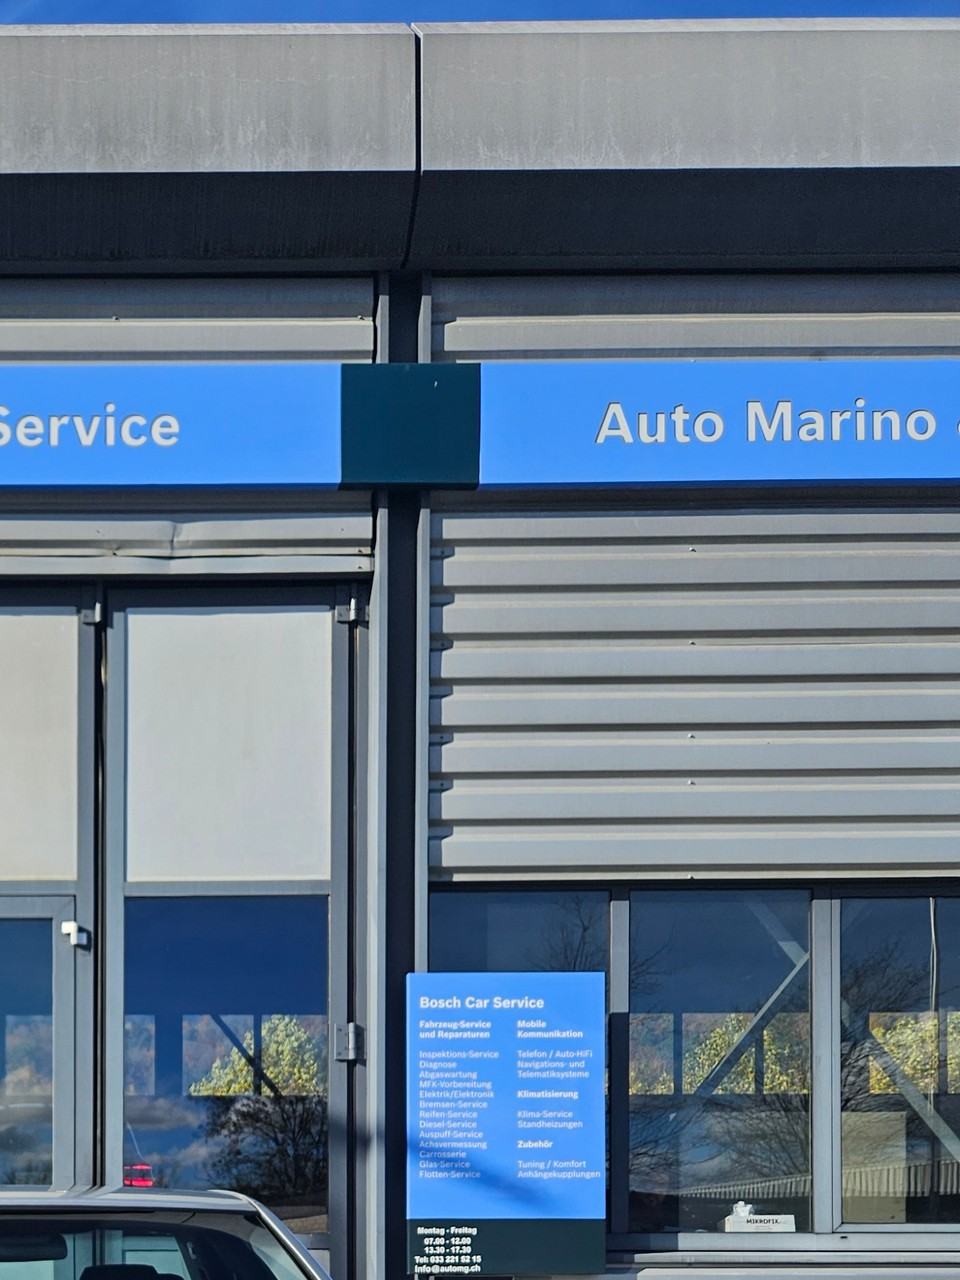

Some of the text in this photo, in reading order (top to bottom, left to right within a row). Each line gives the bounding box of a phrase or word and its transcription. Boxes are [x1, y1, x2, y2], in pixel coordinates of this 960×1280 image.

[594, 401, 723, 443] Auto
[746, 398, 936, 441] Marino
[419, 996, 544, 1009] Bosch Car Service
[419, 1020, 492, 1030] Fahrzeug-Service
[517, 1020, 546, 1028] Mobile
[419, 1030, 490, 1040] und Reparaturen
[517, 1030, 583, 1038] Kommunikation
[419, 1050, 499, 1060] Inspektions-Service
[517, 1050, 547, 1058] Telefon
[555, 1050, 593, 1058] Auto-HiFi
[419, 1060, 457, 1070] Diagnose
[517, 1060, 585, 1070] Navigations- und
[419, 1070, 478, 1080] Abgaswartung
[517, 1070, 590, 1080] Telematiksysteme
[419, 1080, 492, 1090] MFK-Vorbereitung
[419, 1090, 495, 1099] Elektrik/Elektronik
[517, 1090, 579, 1100] Klimatisierung
[419, 1100, 488, 1109] Bremsen-Service
[419, 1110, 478, 1118] Reifen-Service
[517, 1110, 573, 1118] Klima-Service
[419, 1120, 477, 1128] Diesel-Service
[517, 1120, 583, 1130] Standheizungen
[419, 1130, 484, 1139] Auspuff-Service
[419, 1140, 488, 1150] Achsvermessung
[517, 1140, 553, 1148] Zubehör
[419, 1150, 467, 1158] Carrosserie
[419, 1160, 471, 1168] Glas-Service
[517, 1160, 545, 1170] Tuning
[553, 1160, 586, 1168] Komfort
[419, 1170, 481, 1178] Flotten-Service
[517, 1170, 601, 1180] Anhängekupplungen
[417, 1226, 445, 1236] Montag
[450, 1226, 478, 1236] Freitag
[423, 1237, 445, 1245] 07.00
[450, 1237, 472, 1245] 12.00
[424, 1246, 445, 1254] 13.30
[450, 1246, 472, 1254] 17.30
[429, 1255, 444, 1263] 033
[445, 1255, 459, 1263] 221
[471, 1255, 482, 1263] 15
